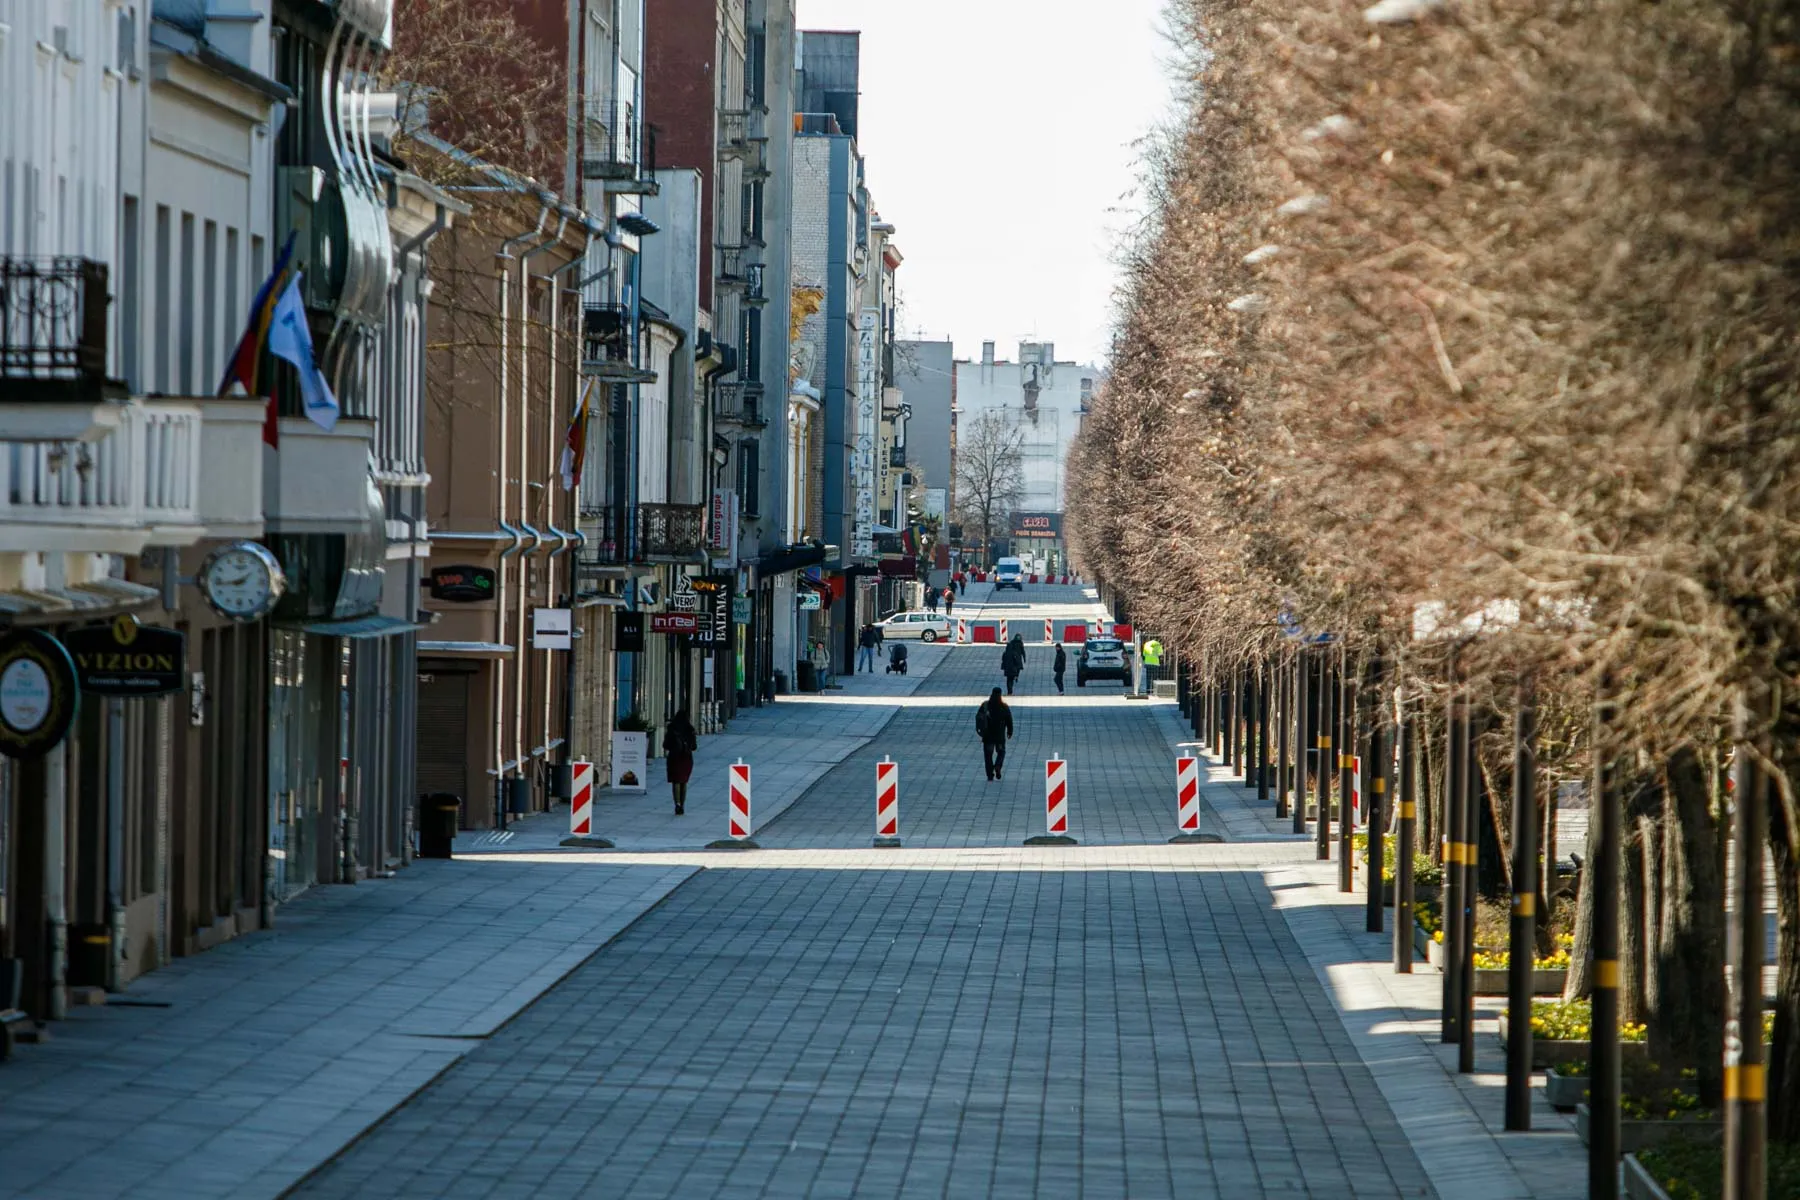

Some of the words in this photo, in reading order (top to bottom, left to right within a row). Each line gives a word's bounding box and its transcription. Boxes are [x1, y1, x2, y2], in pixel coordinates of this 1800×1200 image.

[675, 596, 695, 606] VERO
[668, 617, 695, 627] real
[76, 653, 174, 671] VIZION
